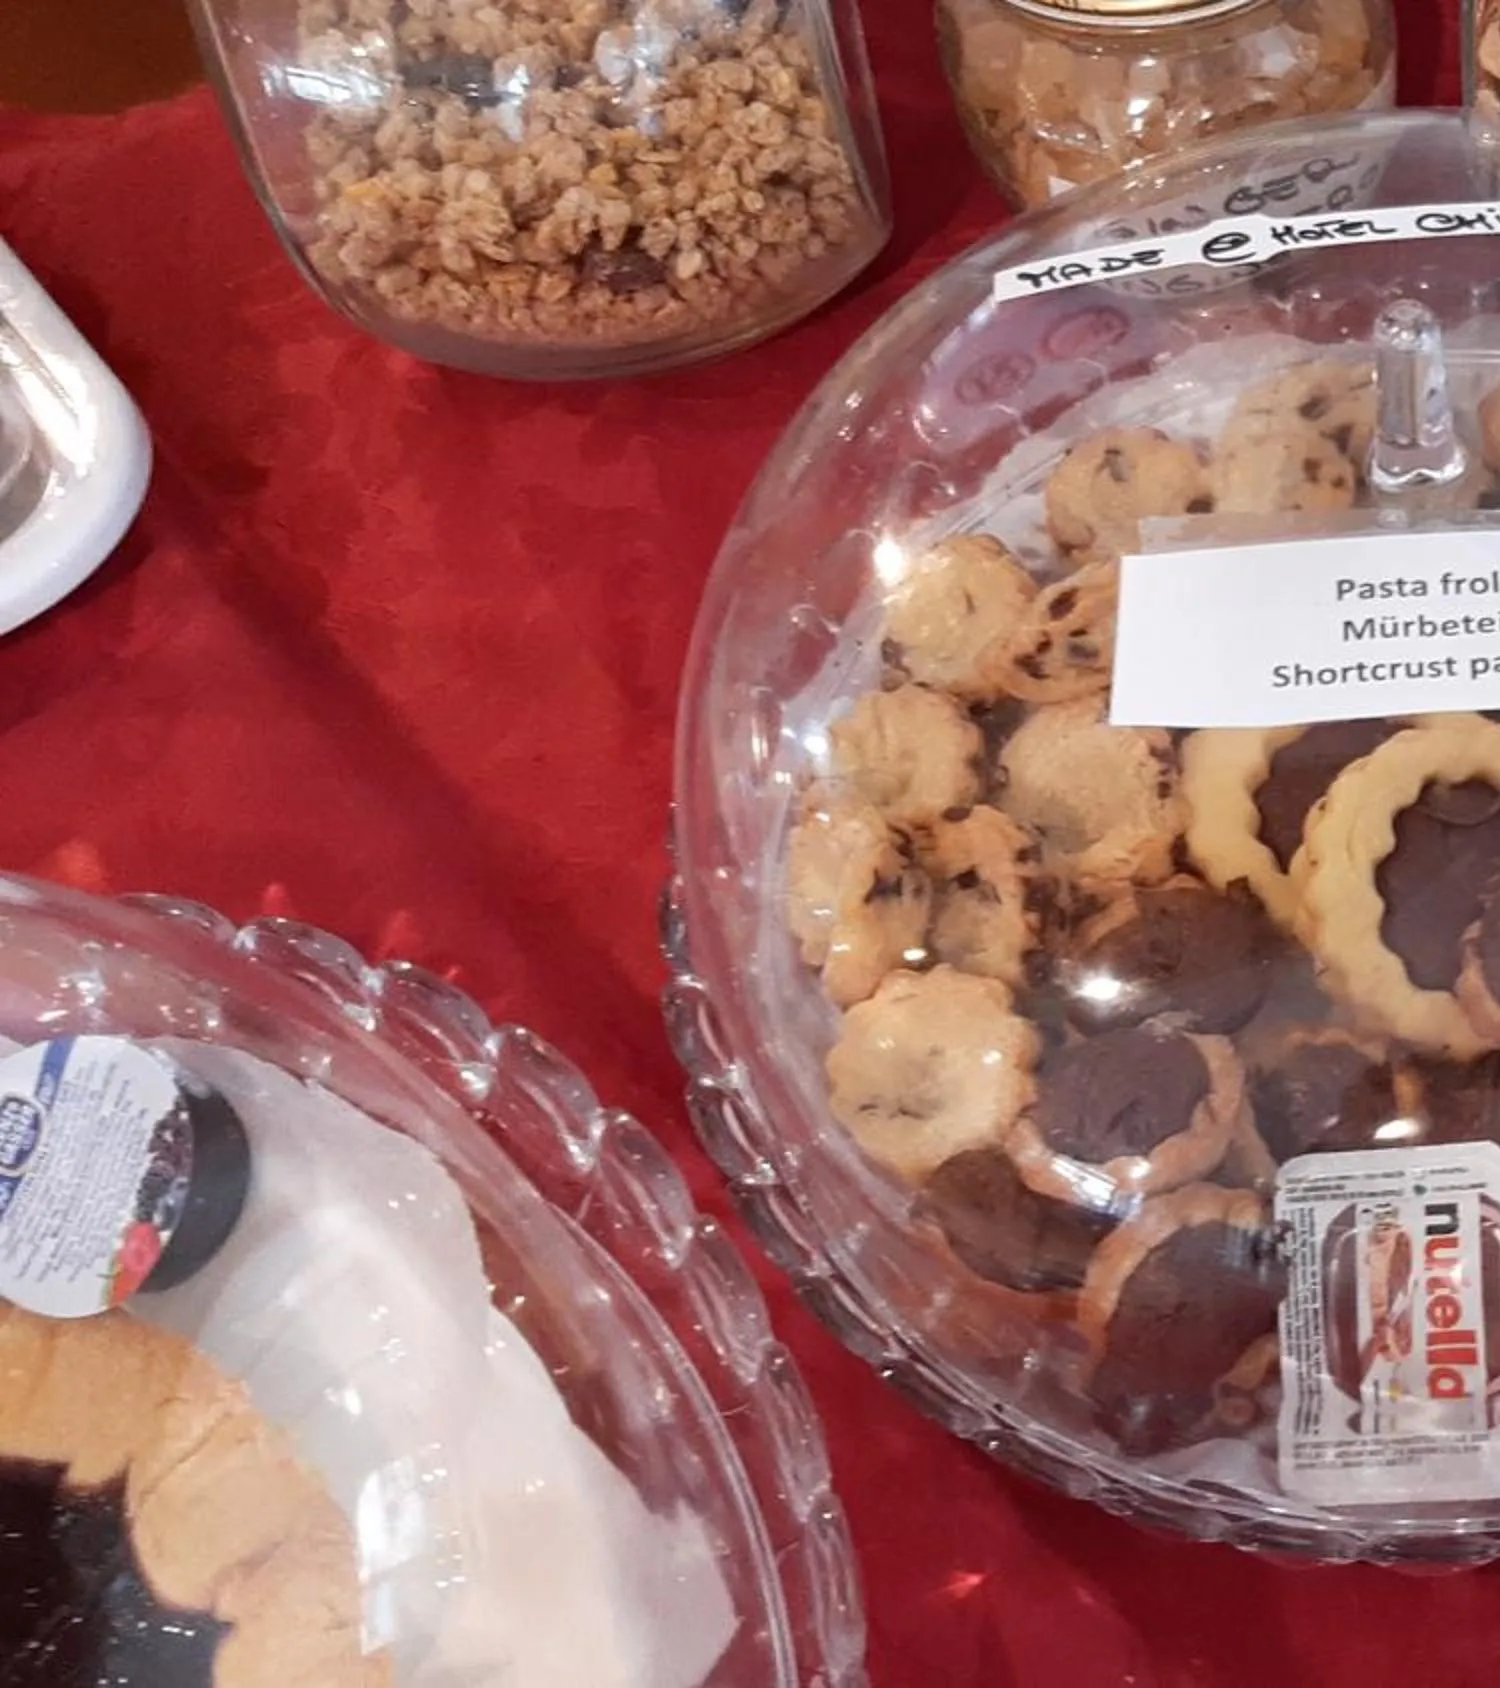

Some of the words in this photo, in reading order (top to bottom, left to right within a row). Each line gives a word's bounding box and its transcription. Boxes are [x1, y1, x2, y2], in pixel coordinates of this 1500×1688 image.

[1016, 248, 1167, 289] MADE
[1335, 577, 1428, 602] Pasta
[1272, 656, 1459, 688] Shortcrust
[1424, 1202, 1480, 1400] nutella
